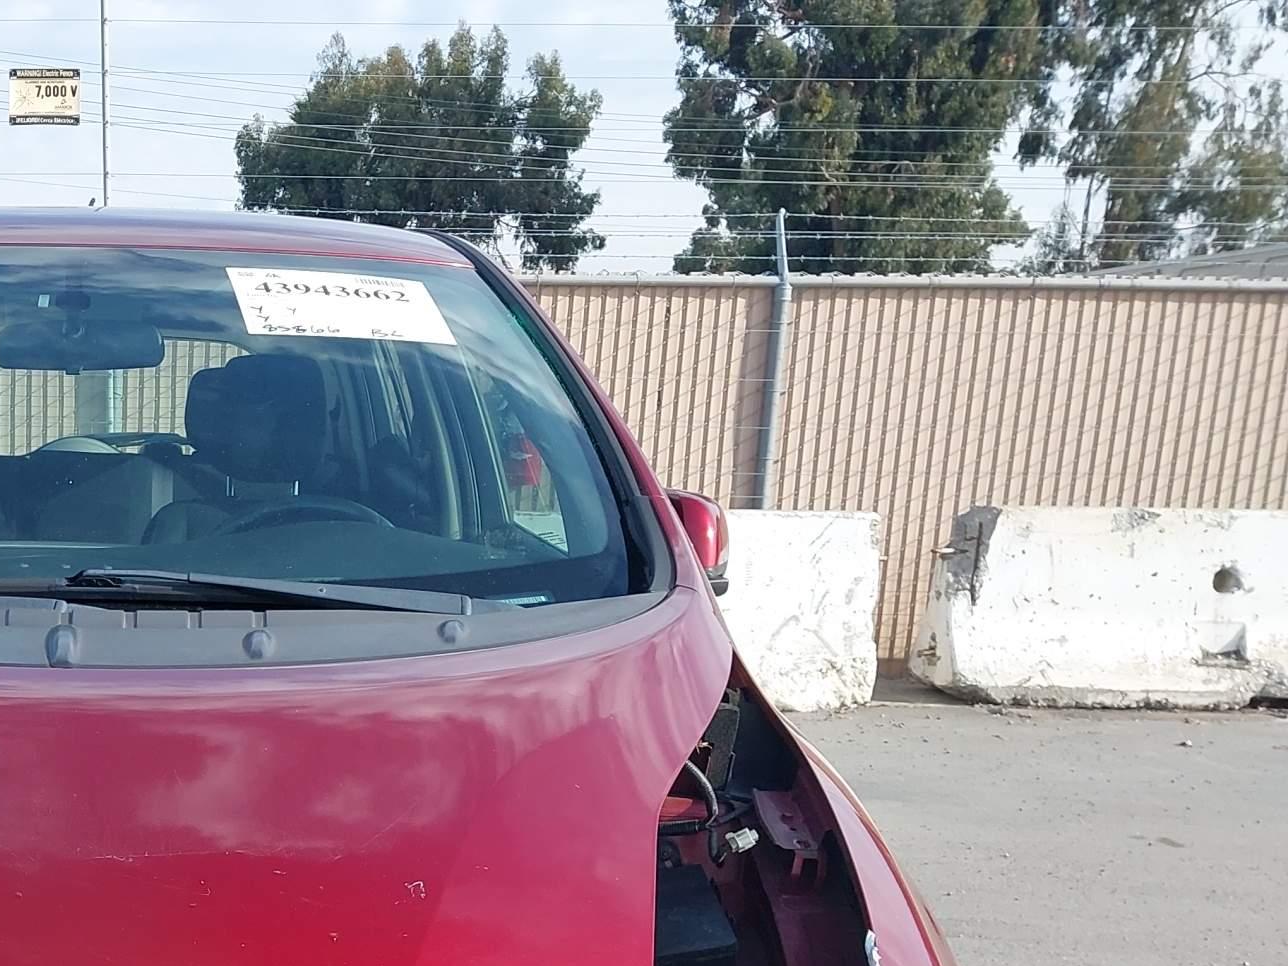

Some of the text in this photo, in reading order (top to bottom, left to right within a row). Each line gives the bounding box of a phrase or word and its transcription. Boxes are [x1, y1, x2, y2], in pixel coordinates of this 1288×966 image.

[35, 85, 78, 99] 7,000 V
[255, 281, 410, 303] 43943662
